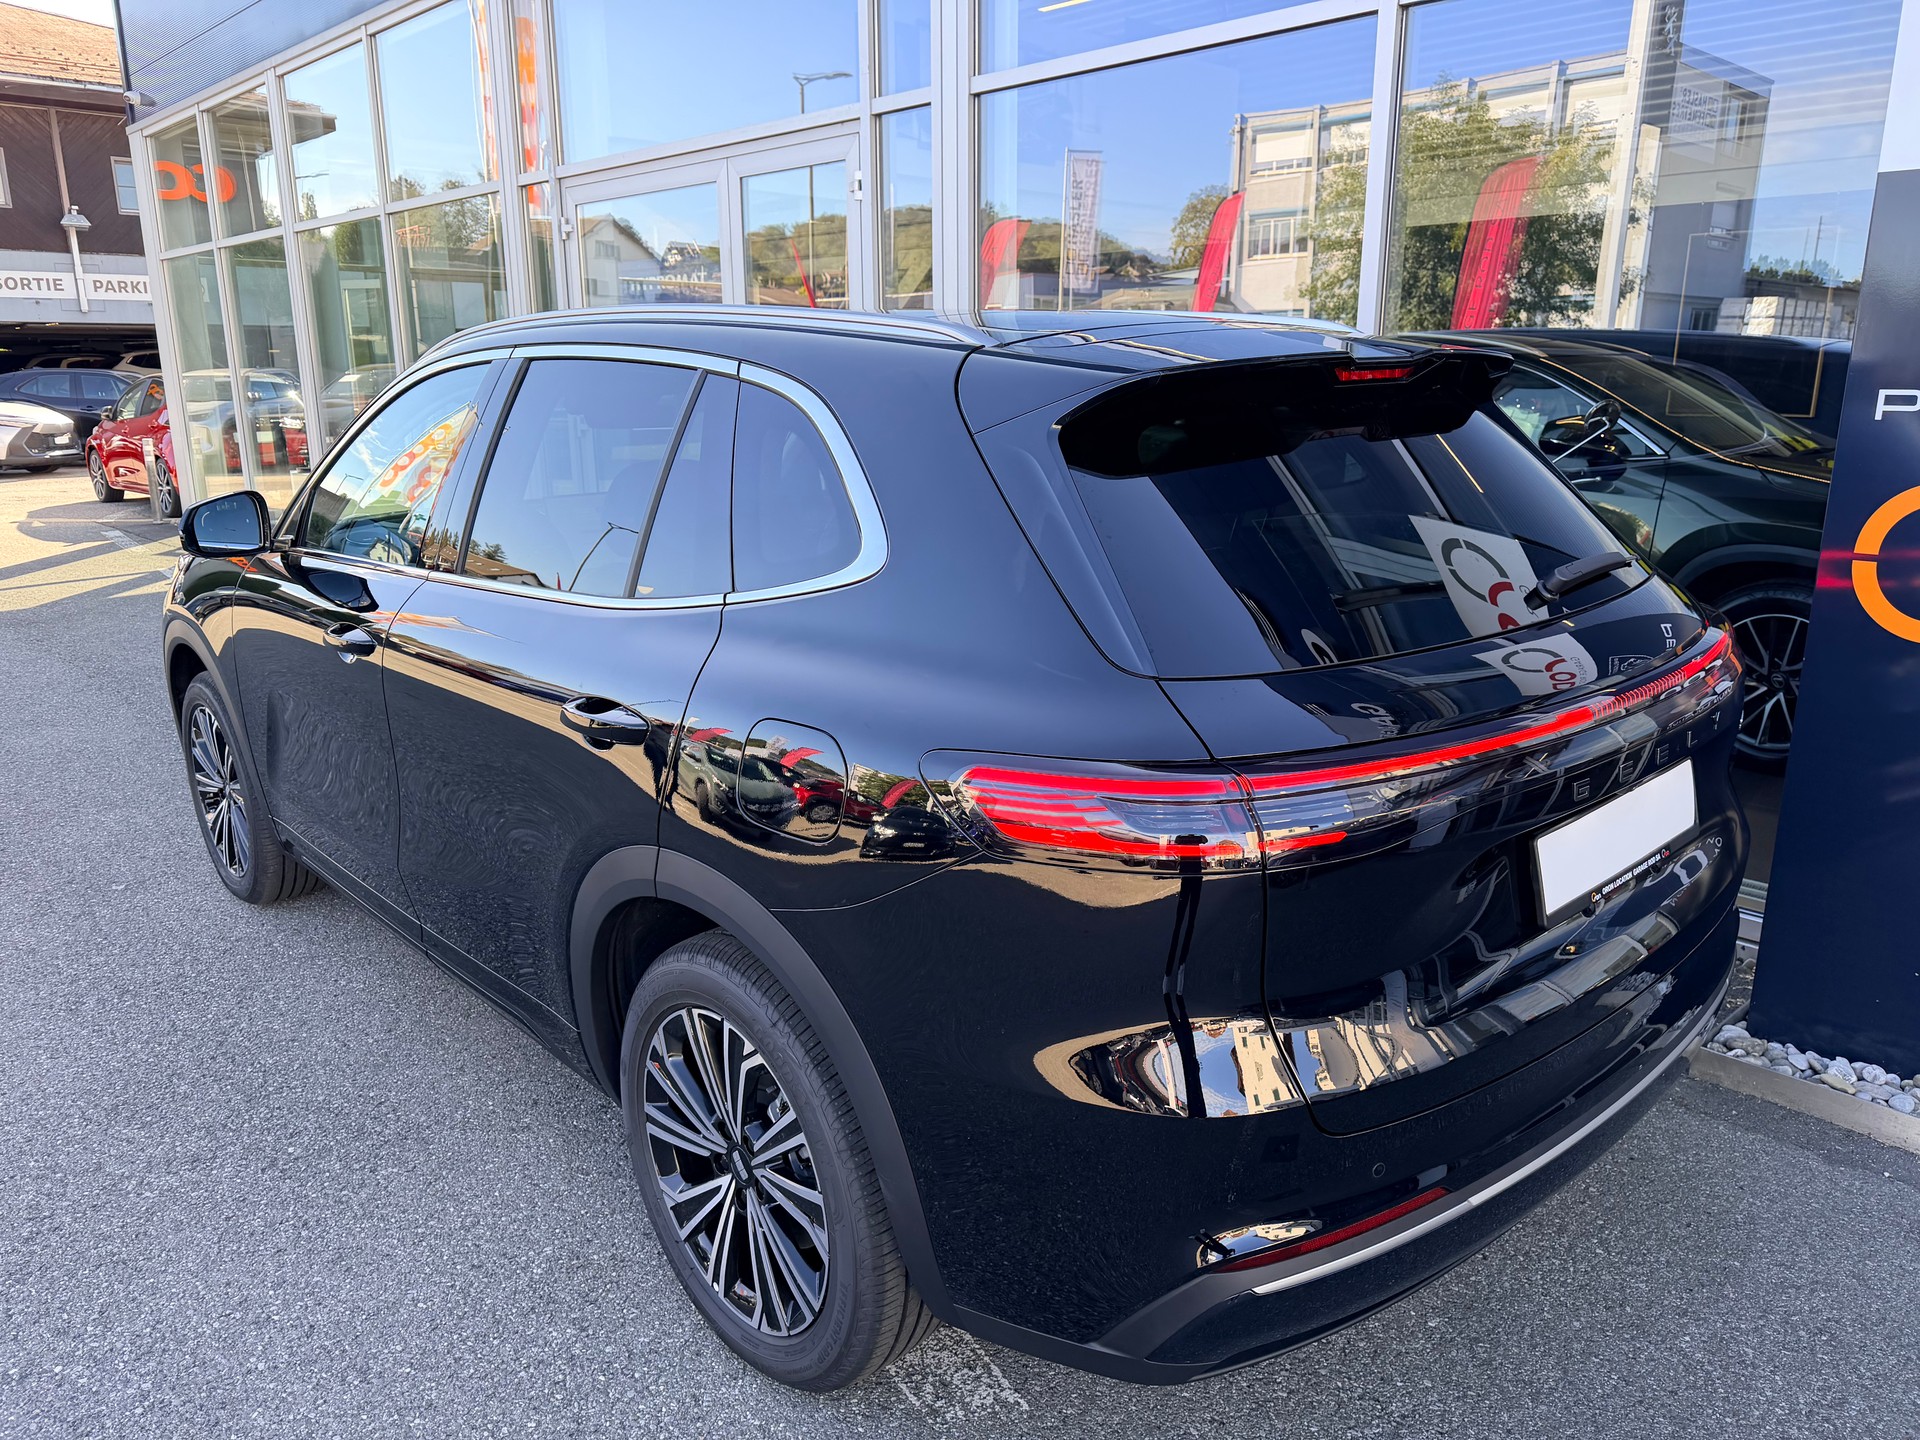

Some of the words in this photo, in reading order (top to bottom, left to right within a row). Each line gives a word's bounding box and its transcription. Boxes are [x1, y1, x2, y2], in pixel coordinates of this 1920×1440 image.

[1573, 710, 1721, 802] GEELY
[1613, 871, 1633, 888] LOCATION
[1633, 861, 1648, 876] GARAGE
